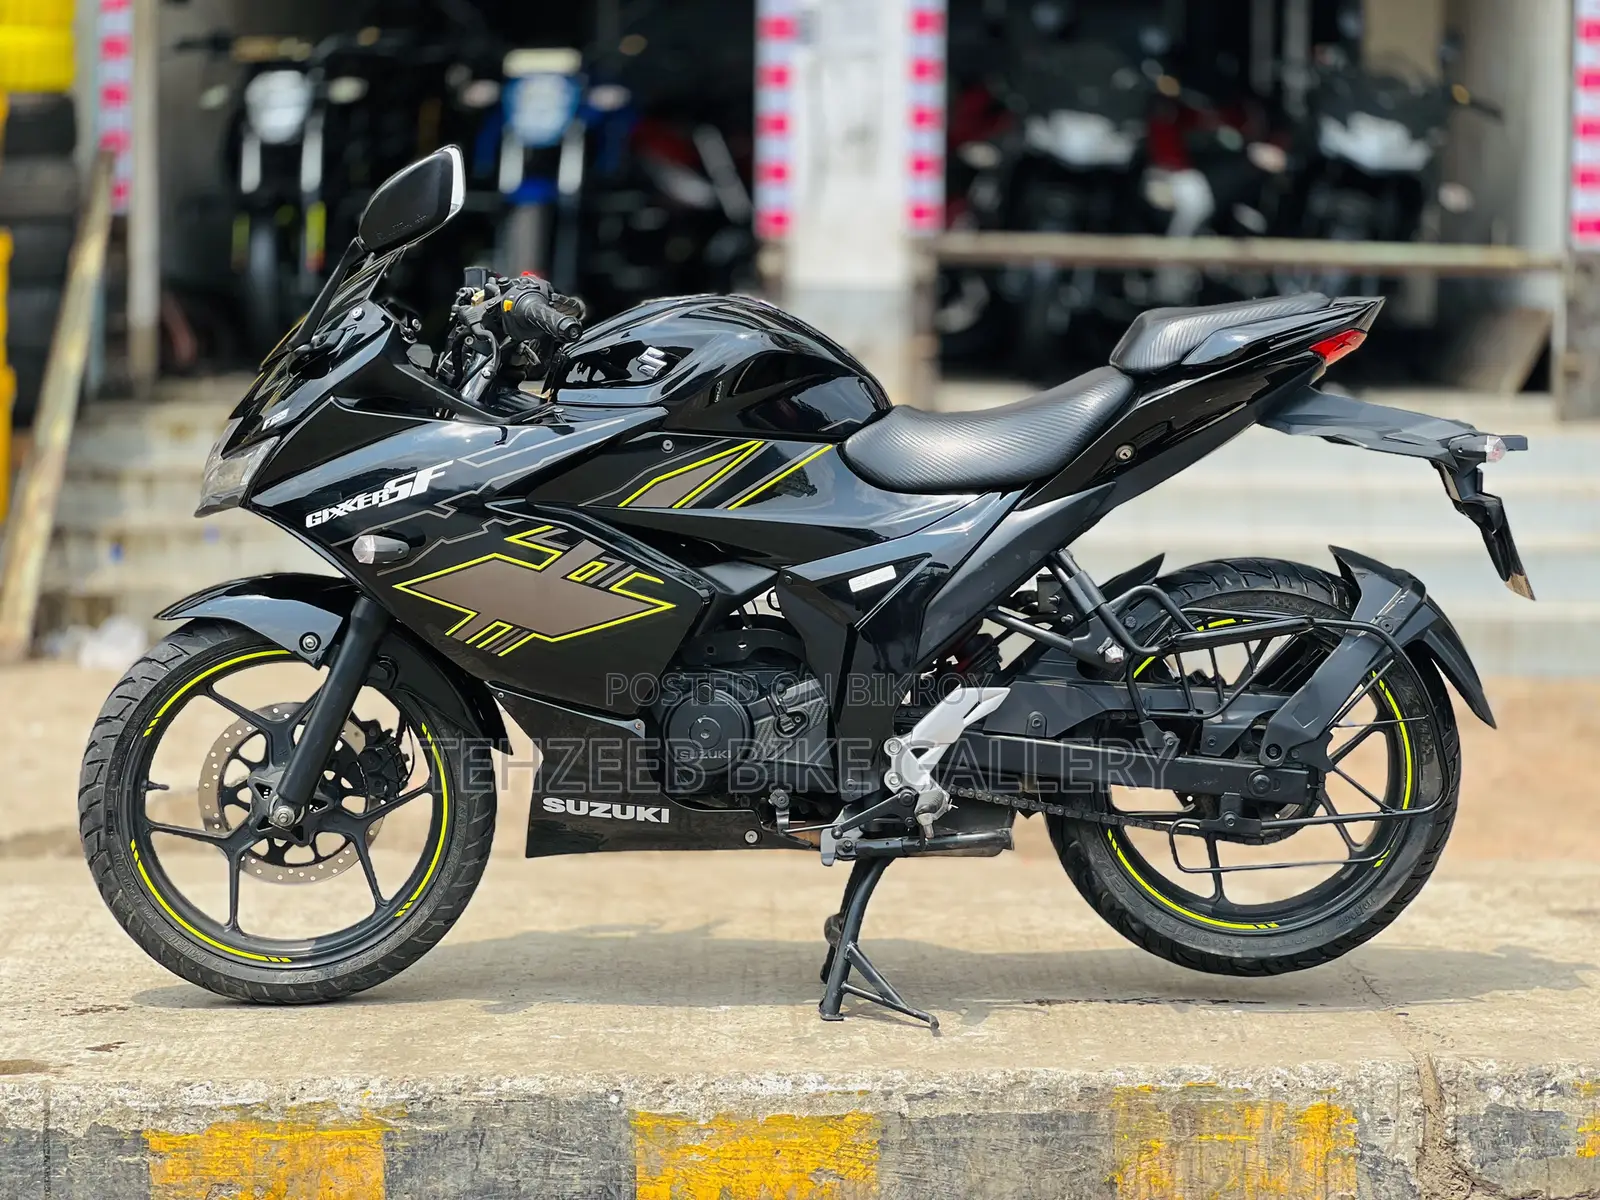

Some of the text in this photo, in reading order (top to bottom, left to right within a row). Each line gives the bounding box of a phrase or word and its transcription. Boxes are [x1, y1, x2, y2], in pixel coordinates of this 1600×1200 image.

[305, 459, 454, 529] GIXXER SF
[680, 749, 732, 759] SUZUKI
[542, 797, 670, 823] SUZUKI
